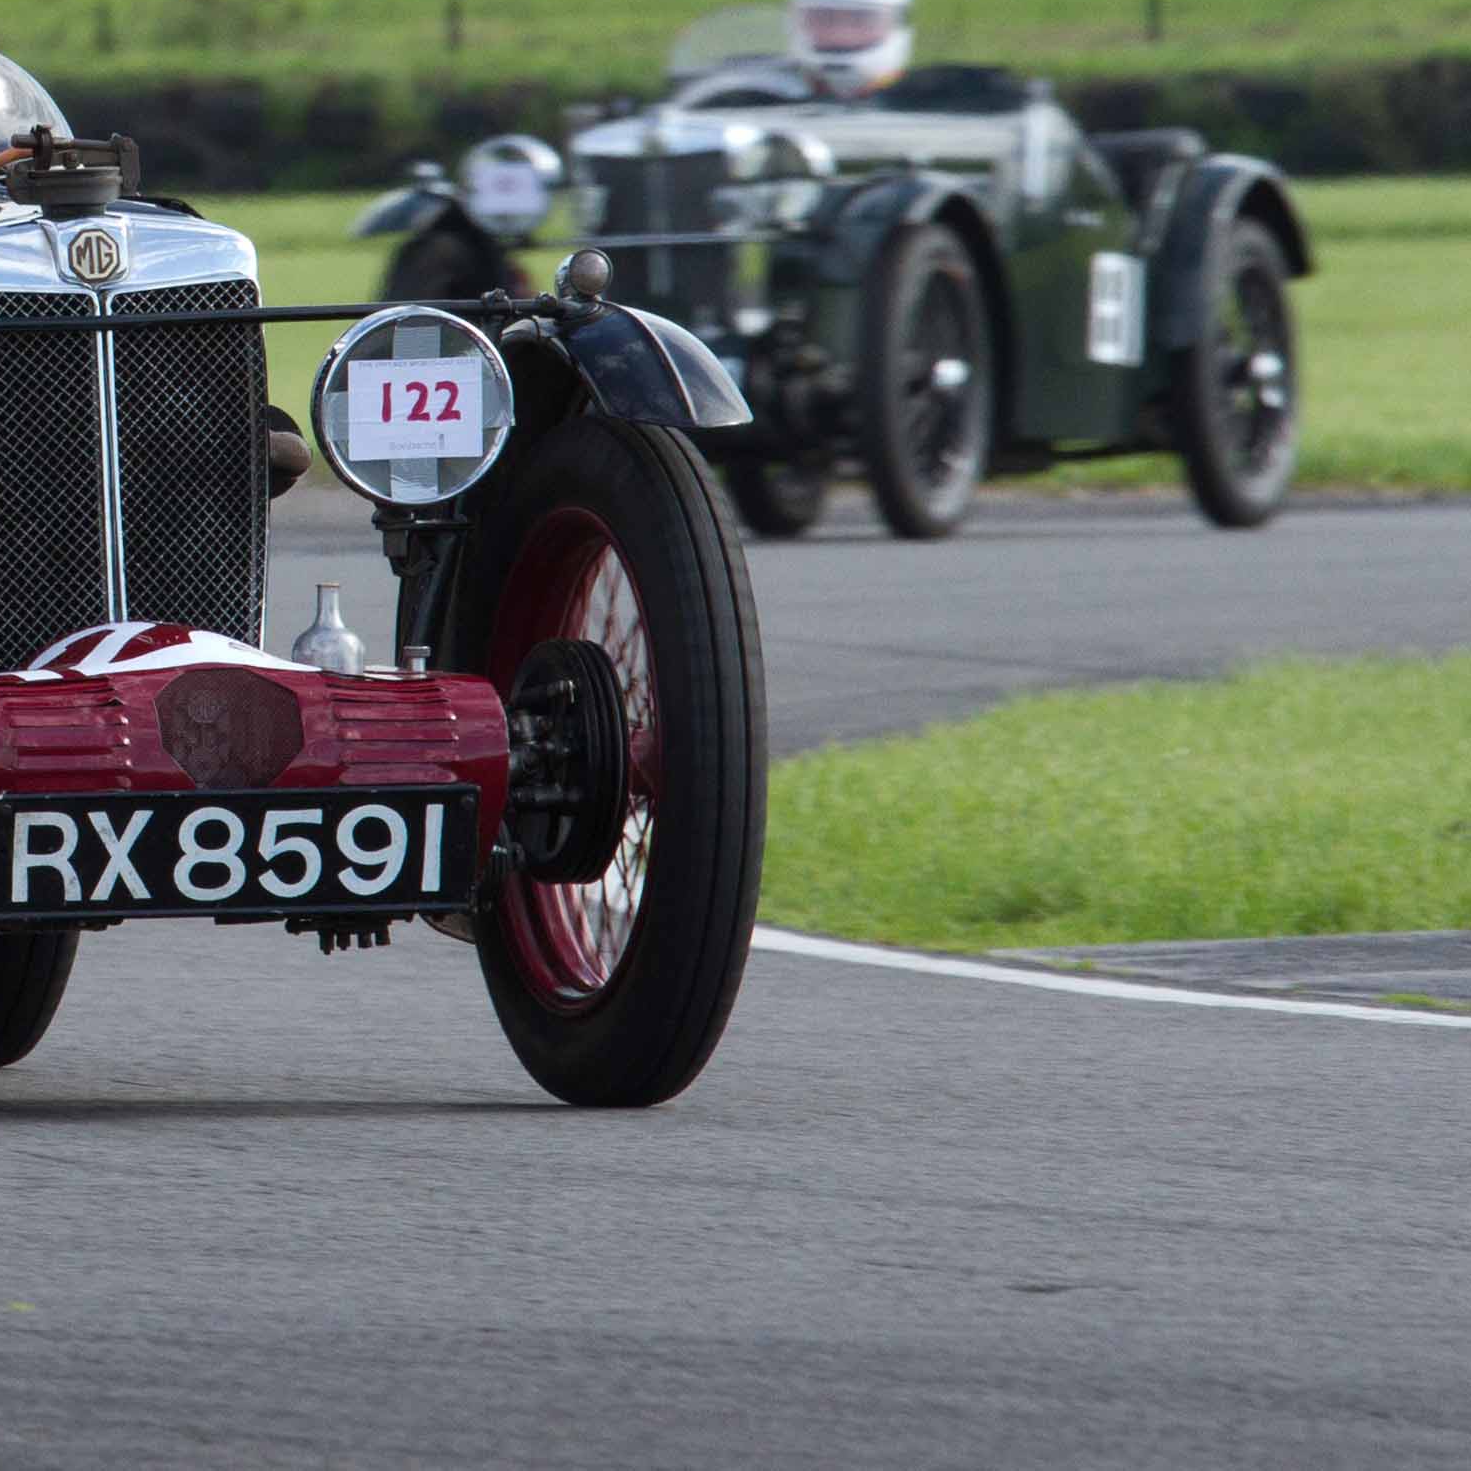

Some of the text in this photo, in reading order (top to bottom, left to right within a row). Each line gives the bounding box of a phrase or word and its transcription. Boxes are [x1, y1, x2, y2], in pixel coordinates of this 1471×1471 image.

[381, 380, 461, 423] 122
[11, 803, 446, 903] RX 8591
